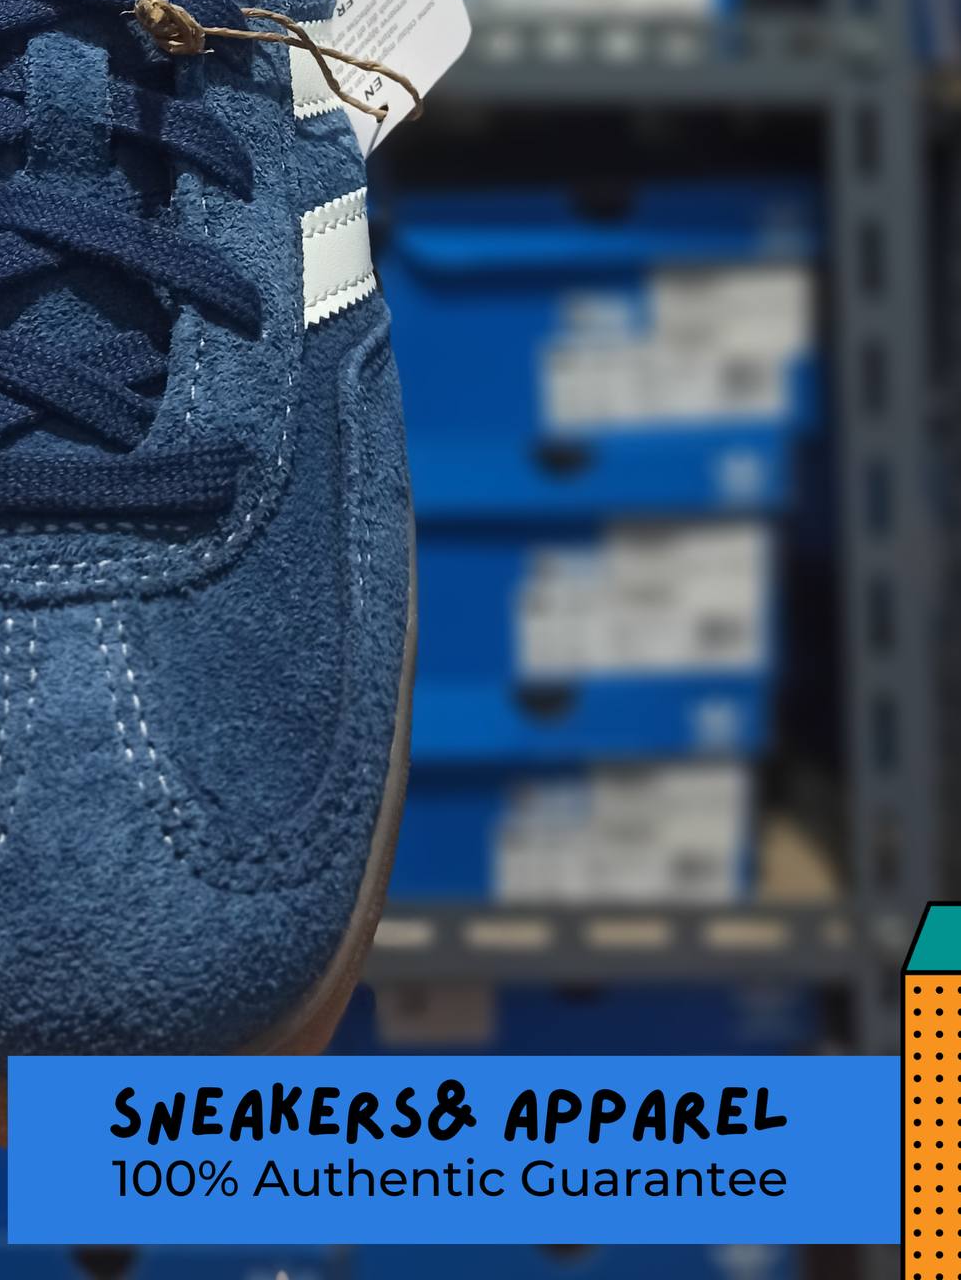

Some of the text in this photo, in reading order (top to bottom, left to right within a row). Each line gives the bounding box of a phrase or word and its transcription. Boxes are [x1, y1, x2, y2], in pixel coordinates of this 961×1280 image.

[417, 0, 434, 20] some
[366, 12, 377, 28] dirt
[356, 25, 366, 39] off
[377, 23, 398, 48] nature
[397, 18, 417, 43] colour
[343, 35, 356, 52] and
[354, 73, 365, 87] can
[364, 76, 384, 102] EN
